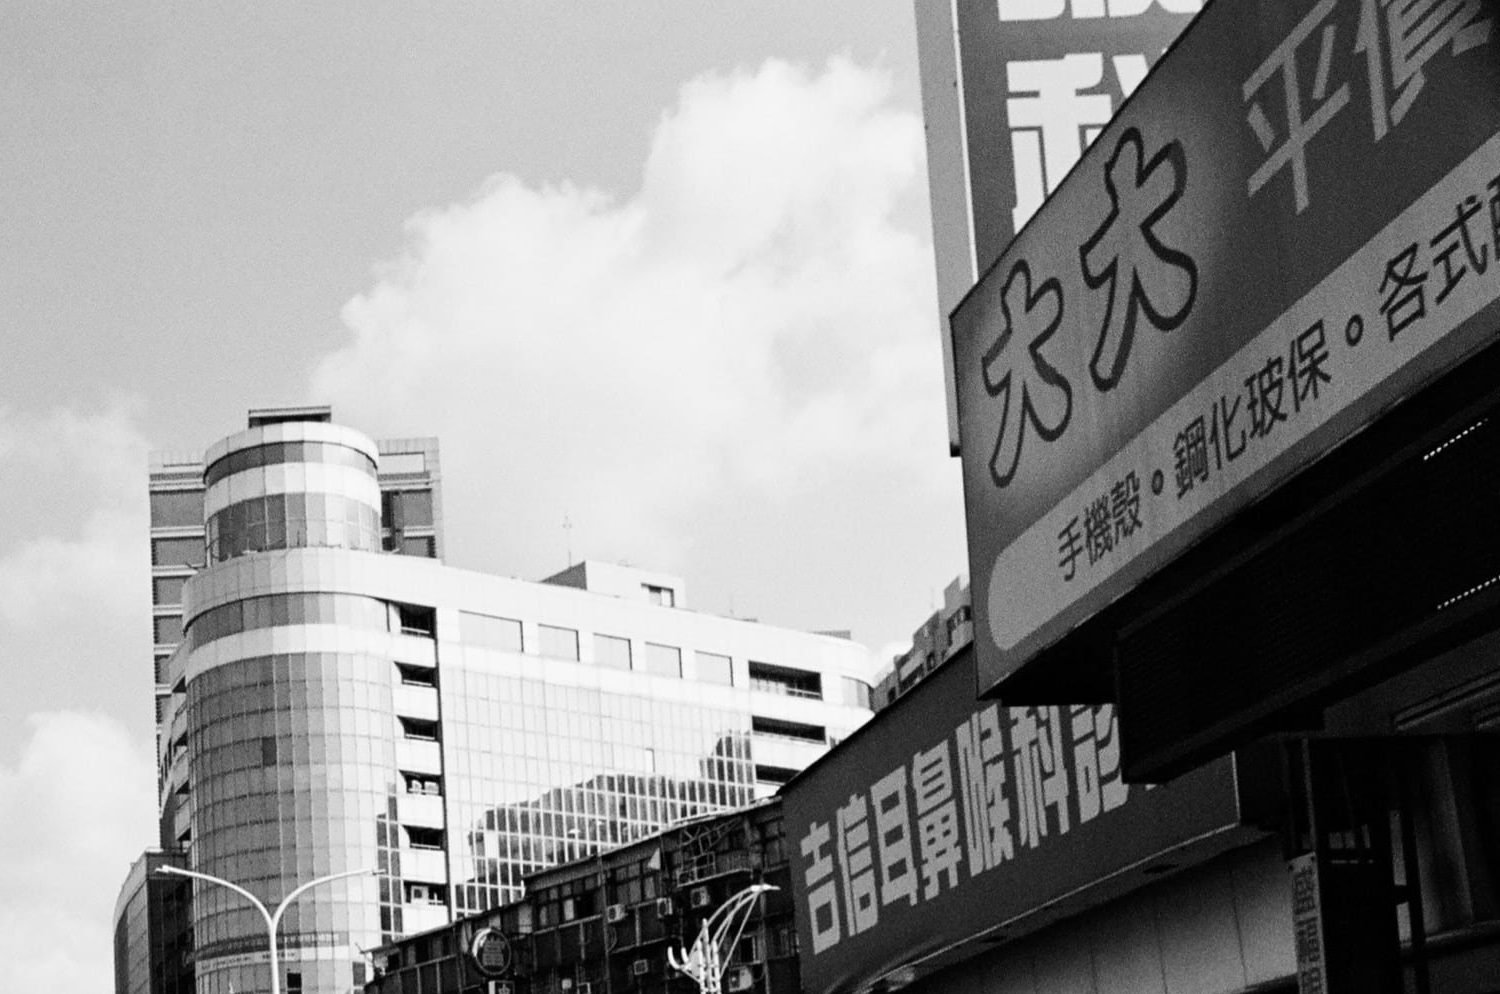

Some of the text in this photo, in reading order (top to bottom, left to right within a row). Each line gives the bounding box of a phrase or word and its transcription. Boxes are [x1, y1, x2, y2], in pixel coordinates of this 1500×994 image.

[800, 703, 1140, 955] 吉信耳鼻喉科診
